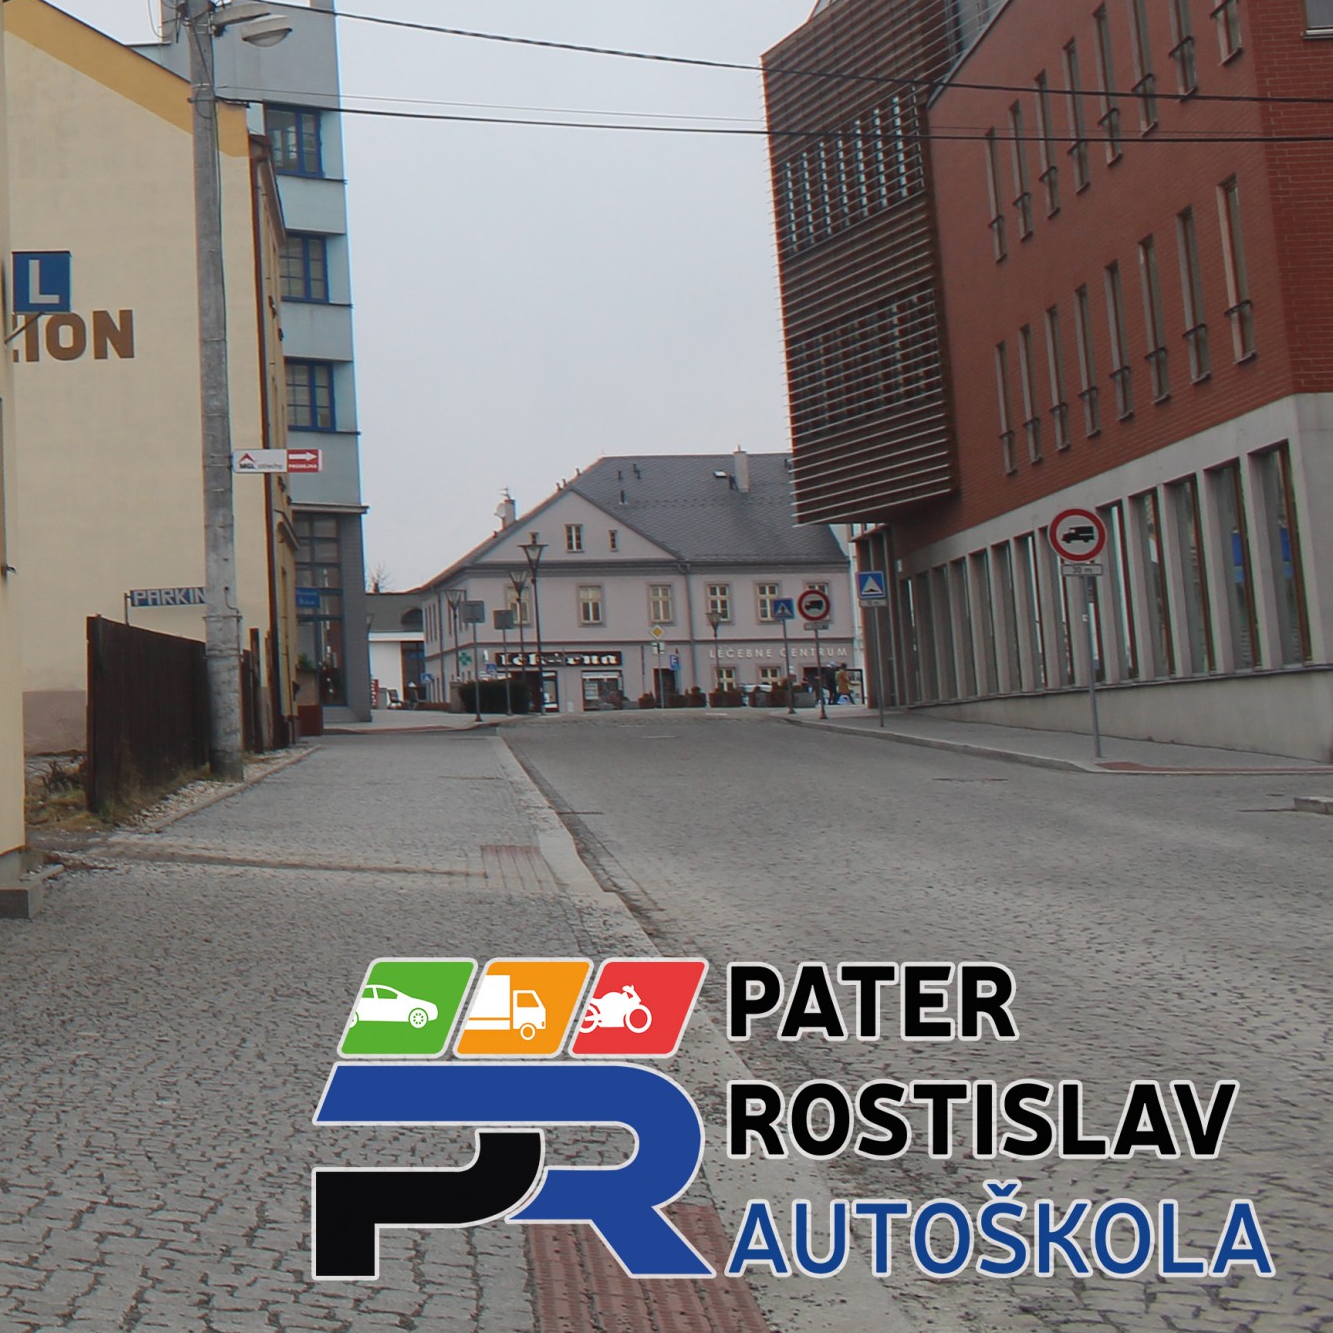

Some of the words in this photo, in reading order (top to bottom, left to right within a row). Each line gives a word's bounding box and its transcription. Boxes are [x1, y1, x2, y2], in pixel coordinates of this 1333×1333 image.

[29, 259, 59, 303] L
[13, 310, 134, 362] ION
[134, 587, 206, 605] PARKIN
